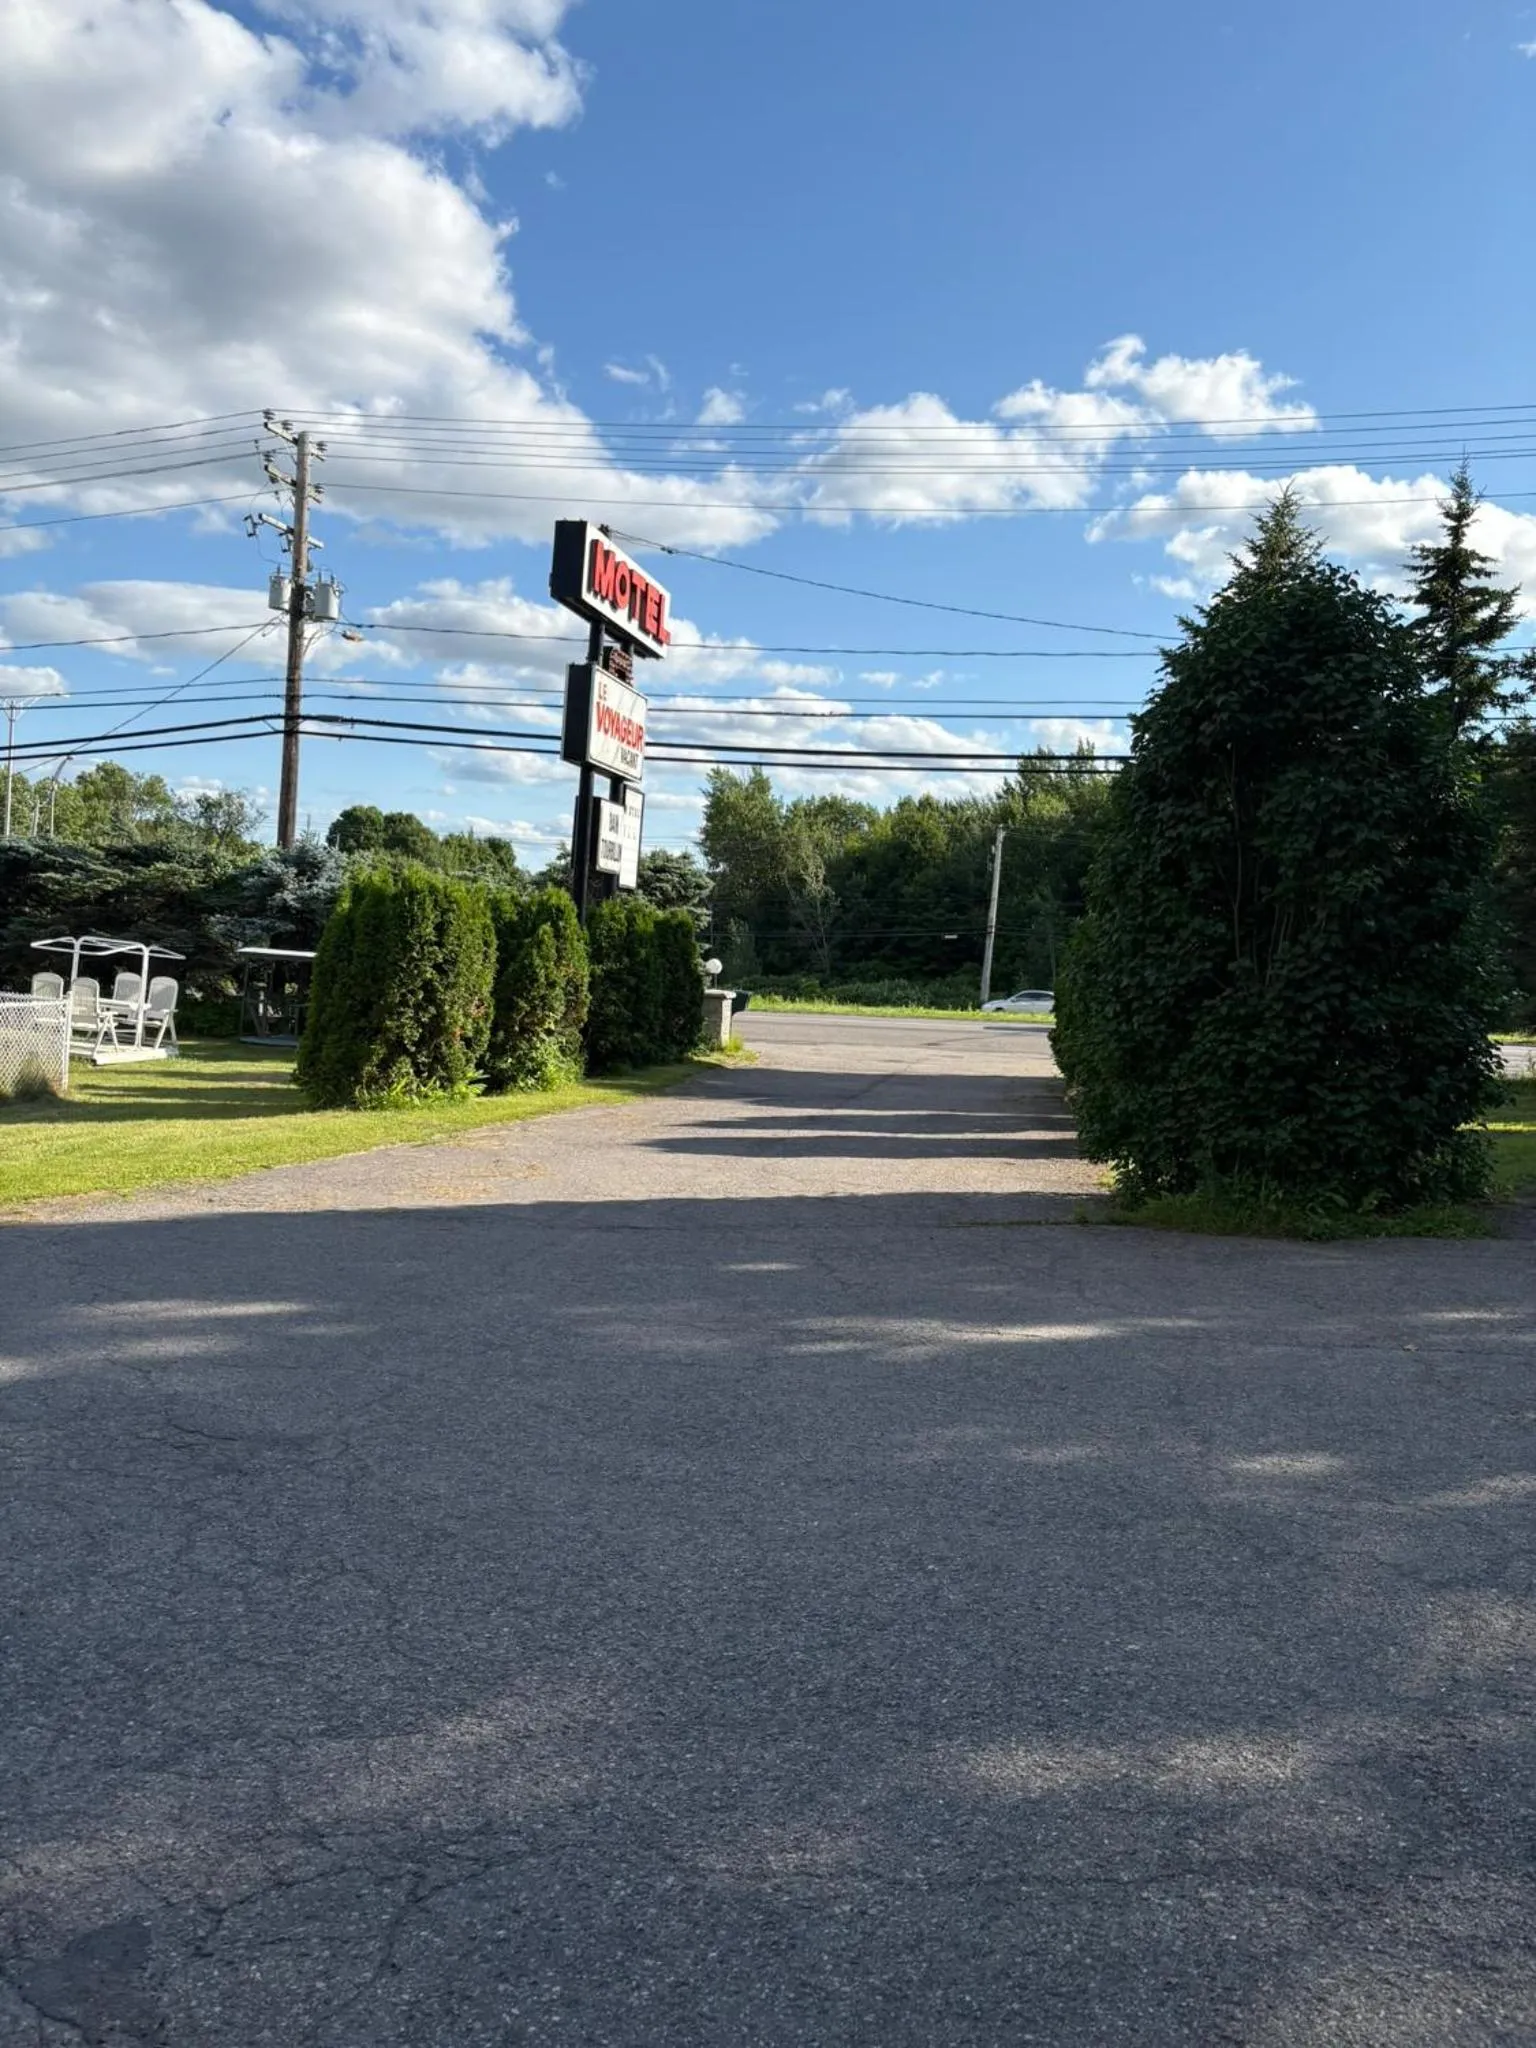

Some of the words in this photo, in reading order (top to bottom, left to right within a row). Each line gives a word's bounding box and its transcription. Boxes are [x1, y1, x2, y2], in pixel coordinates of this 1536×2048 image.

[589, 539, 671, 645] MOTEL
[598, 682, 608, 702] LE
[596, 701, 644, 752] VOYAGEUR
